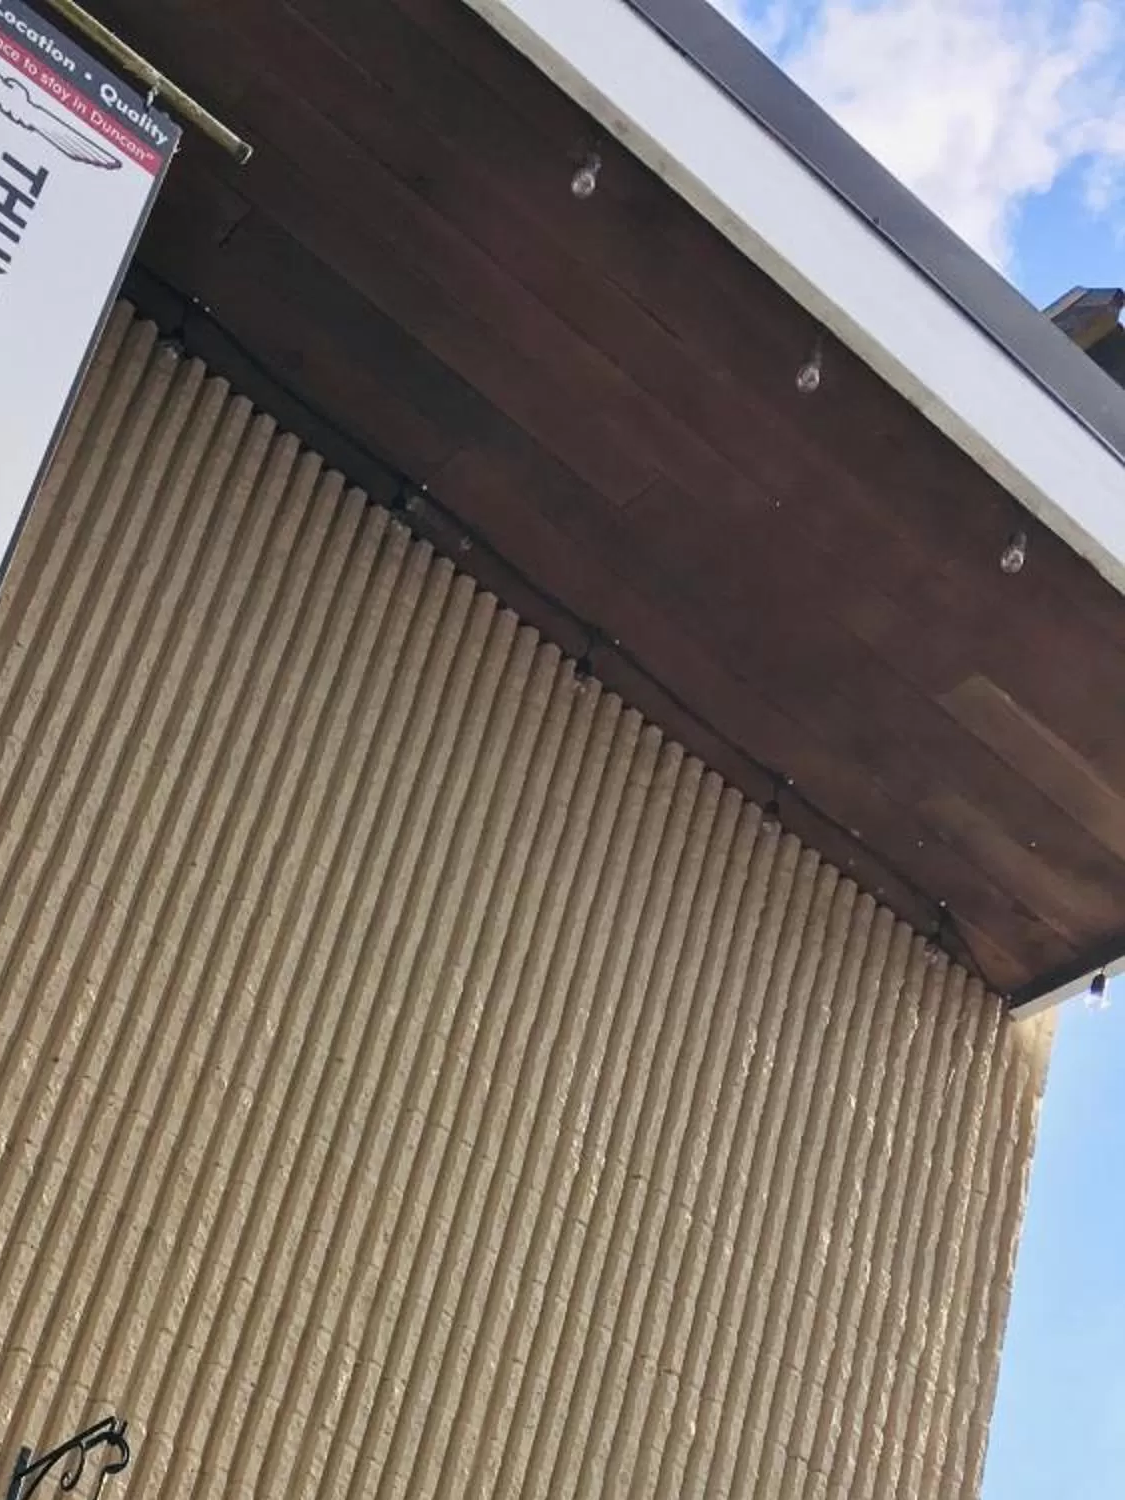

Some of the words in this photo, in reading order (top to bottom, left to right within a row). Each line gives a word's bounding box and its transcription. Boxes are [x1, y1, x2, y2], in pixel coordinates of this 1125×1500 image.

[24, 57, 38, 77] to
[40, 69, 71, 102] stay
[72, 97, 87, 116] in
[100, 83, 169, 147] Quality
